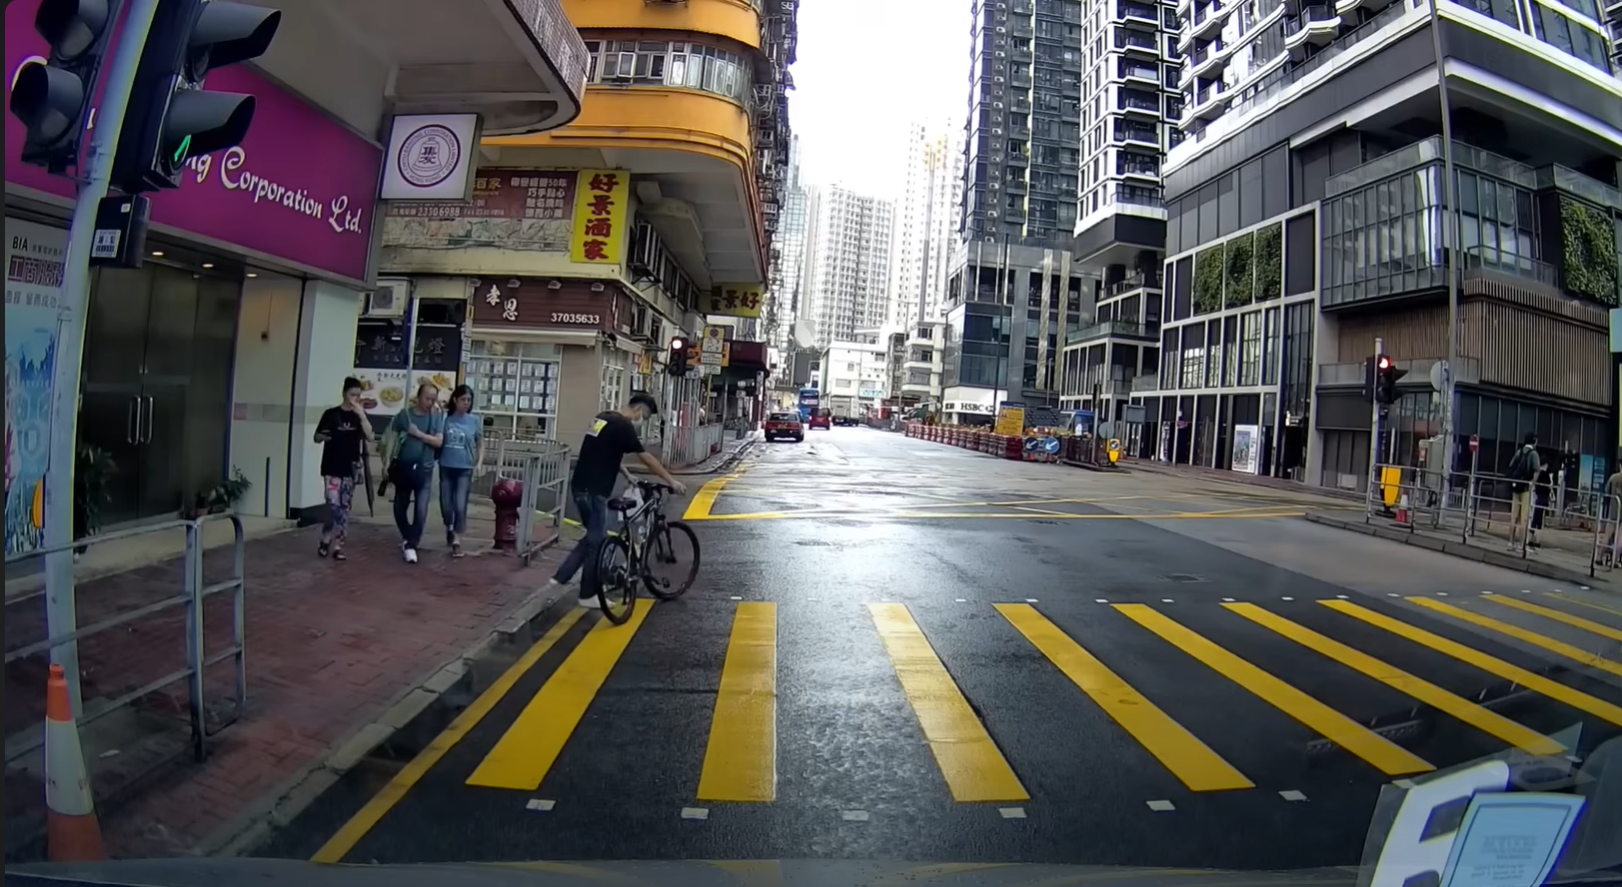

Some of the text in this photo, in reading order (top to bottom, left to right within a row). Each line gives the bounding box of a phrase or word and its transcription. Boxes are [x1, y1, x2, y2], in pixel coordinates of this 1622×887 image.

[221, 146, 323, 219] Corporation
[328, 195, 362, 233] Ltd.
[583, 173, 620, 261] 好景酒家
[13, 236, 28, 251] BIA
[551, 313, 600, 324] 37035633
[961, 402, 984, 412] HSBC
